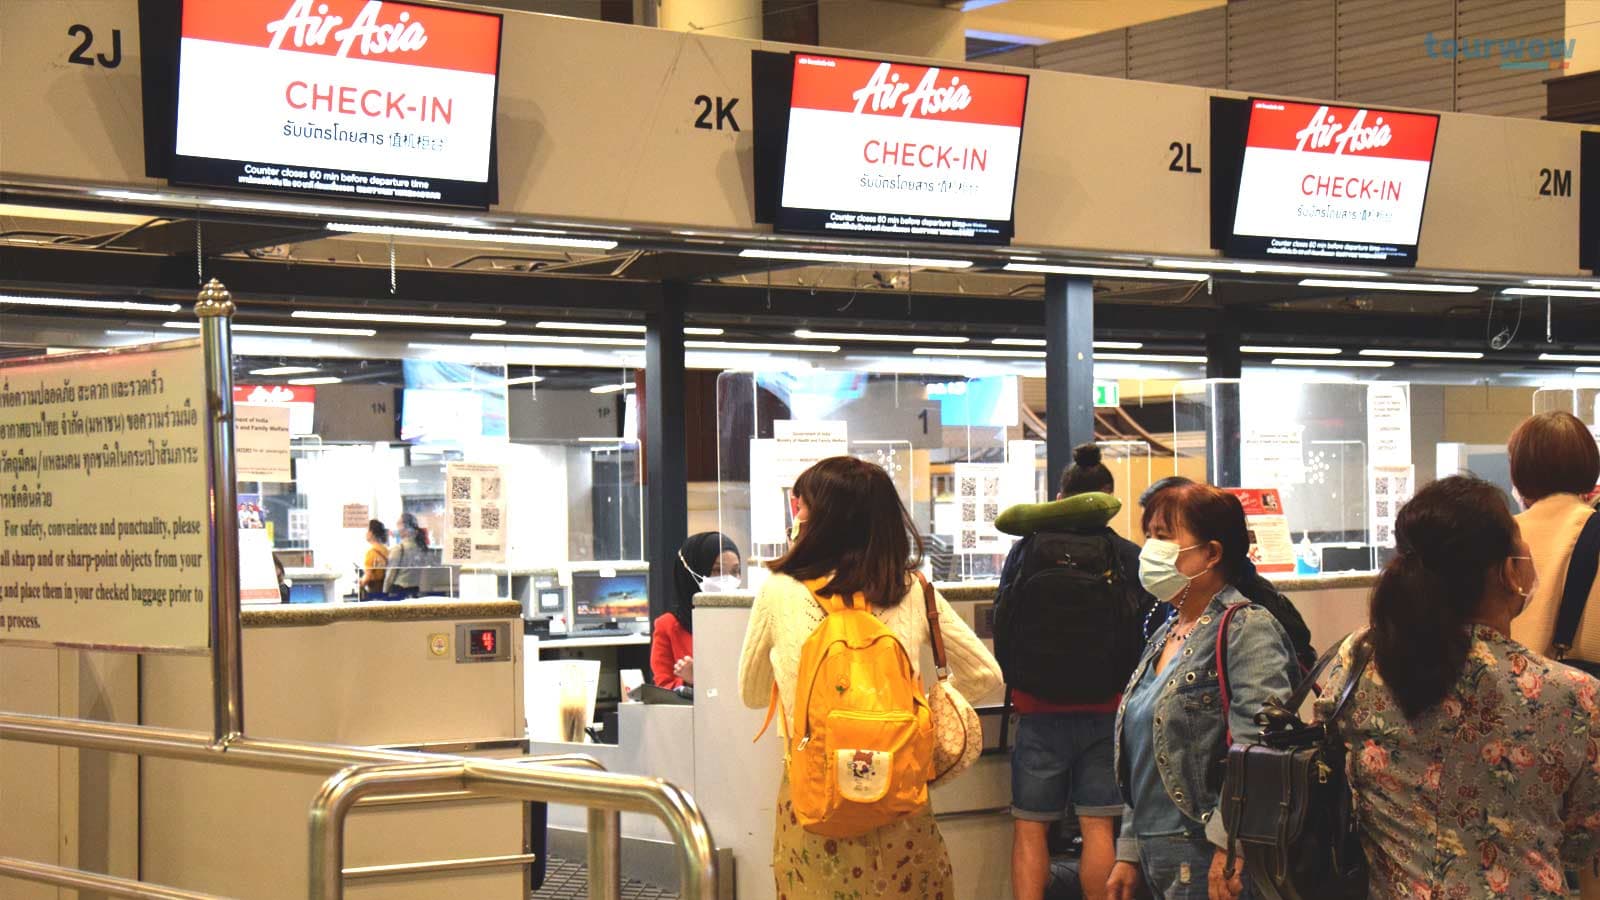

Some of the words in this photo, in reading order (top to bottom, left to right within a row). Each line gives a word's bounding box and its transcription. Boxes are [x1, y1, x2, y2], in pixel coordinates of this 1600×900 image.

[67, 24, 122, 69] 2J
[285, 81, 453, 125] CHECK-IN
[694, 94, 740, 132] 2K
[283, 120, 384, 145] รับบัตรโดยสาร
[864, 140, 987, 171] CHECK-IN
[1169, 142, 1202, 174] 2L
[244, 164, 280, 177] Counter
[281, 168, 308, 180] closes
[309, 170, 321, 180] 60
[323, 171, 339, 182] min
[341, 172, 368, 185] before
[369, 175, 409, 189] departure
[411, 178, 429, 189] time
[1302, 174, 1401, 202] CHECK-IN
[1539, 168, 1571, 197] 2M
[371, 402, 386, 414] 1N
[4, 519, 19, 536] For
[20, 519, 46, 541] safety,
[47, 518, 97, 536] convenience
[100, 517, 115, 535] and
[173, 516, 200, 540] please
[0, 549, 10, 567] all
[12, 549, 35, 572] sharp
[37, 549, 53, 567] and
[55, 554, 65, 567] or
[67, 549, 117, 572] sharp-point
[121, 549, 152, 572] objects
[155, 549, 177, 567] from
[180, 553, 202, 572] your
[4, 581, 19, 598] and
[20, 581, 40, 603] place
[42, 581, 62, 599] them
[64, 582, 72, 599] in
[74, 586, 94, 604] your
[95, 582, 129, 601] checked
[131, 583, 167, 606] baggage
[169, 584, 192, 607] prior
[194, 587, 203, 602] to
[7, 615, 41, 632] process.
